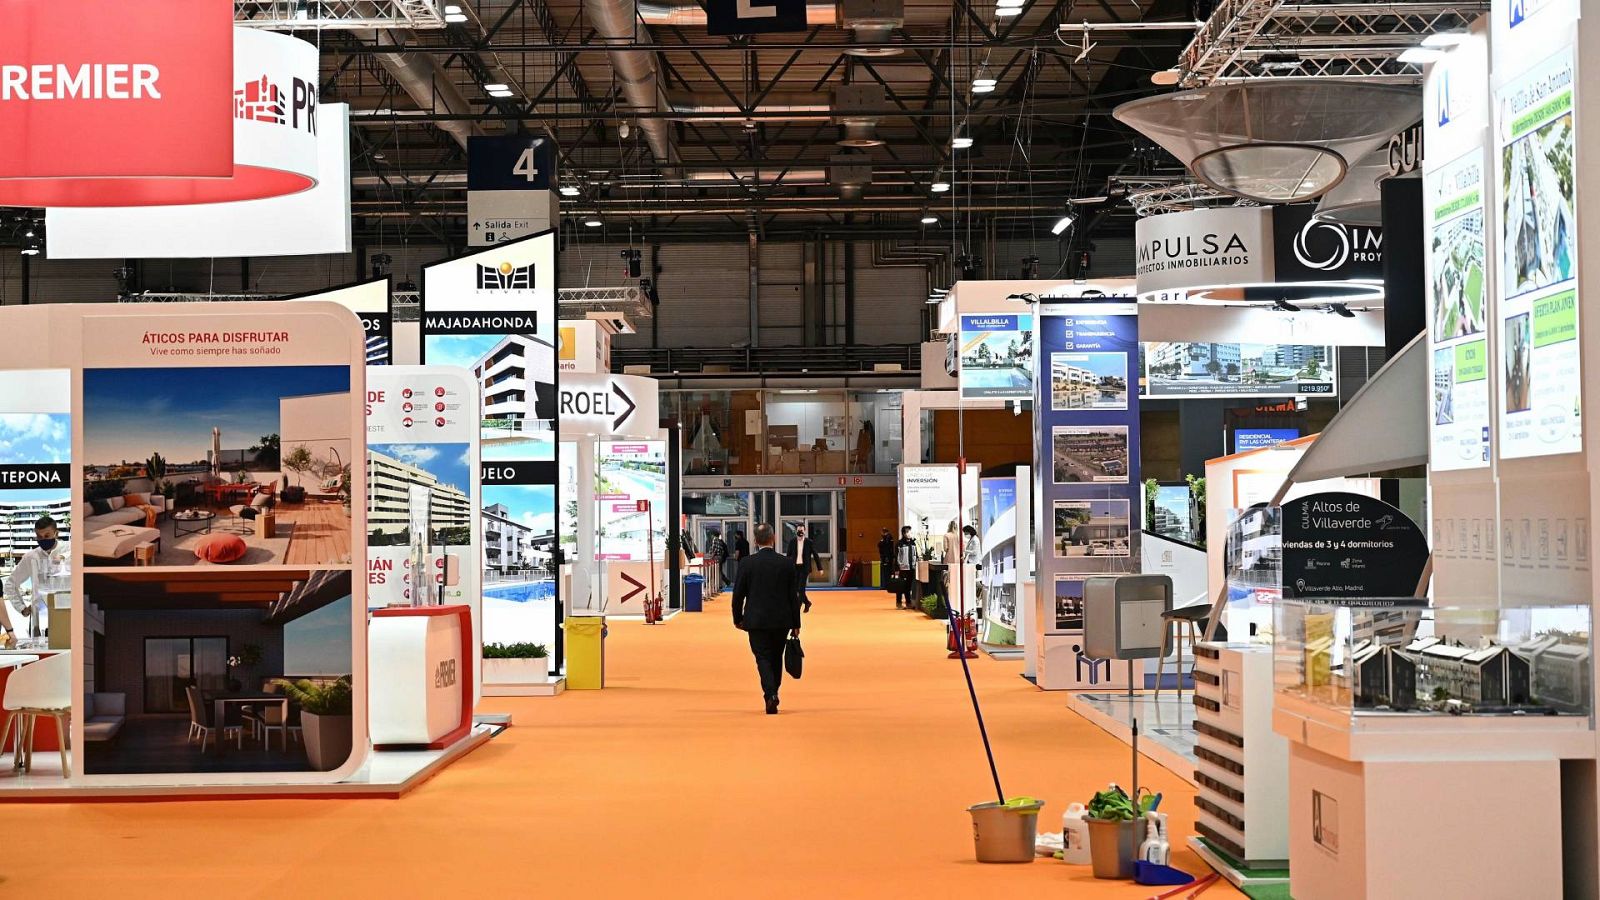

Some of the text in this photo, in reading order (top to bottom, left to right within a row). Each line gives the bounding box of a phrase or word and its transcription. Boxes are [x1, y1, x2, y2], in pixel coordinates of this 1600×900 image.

[2, 64, 161, 100] REMIER
[513, 148, 538, 181] 4
[485, 221, 529, 229] Salida Exit
[1167, 255, 1249, 269] INMOBILIARIOS
[1353, 252, 1382, 261] PROY
[425, 316, 534, 329] MAJADAHONDA
[142, 331, 289, 343] ÁTICOS PARA DISFRUTAR
[150, 347, 168, 355] Vive
[196, 347, 230, 356] siempre
[232, 346, 247, 354] has
[250, 346, 281, 354] soñado
[368, 391, 385, 403] DE
[560, 391, 615, 415] ROEL
[1, 470, 61, 483] TEPONA
[1312, 501, 1360, 513] Altos de
[1312, 517, 1372, 529] Villaverde
[1315, 540, 1325, 548] de
[1333, 542, 1339, 550] y
[1347, 540, 1394, 548] dormitorios
[368, 556, 393, 571] IÁN
[368, 572, 386, 584] ES
